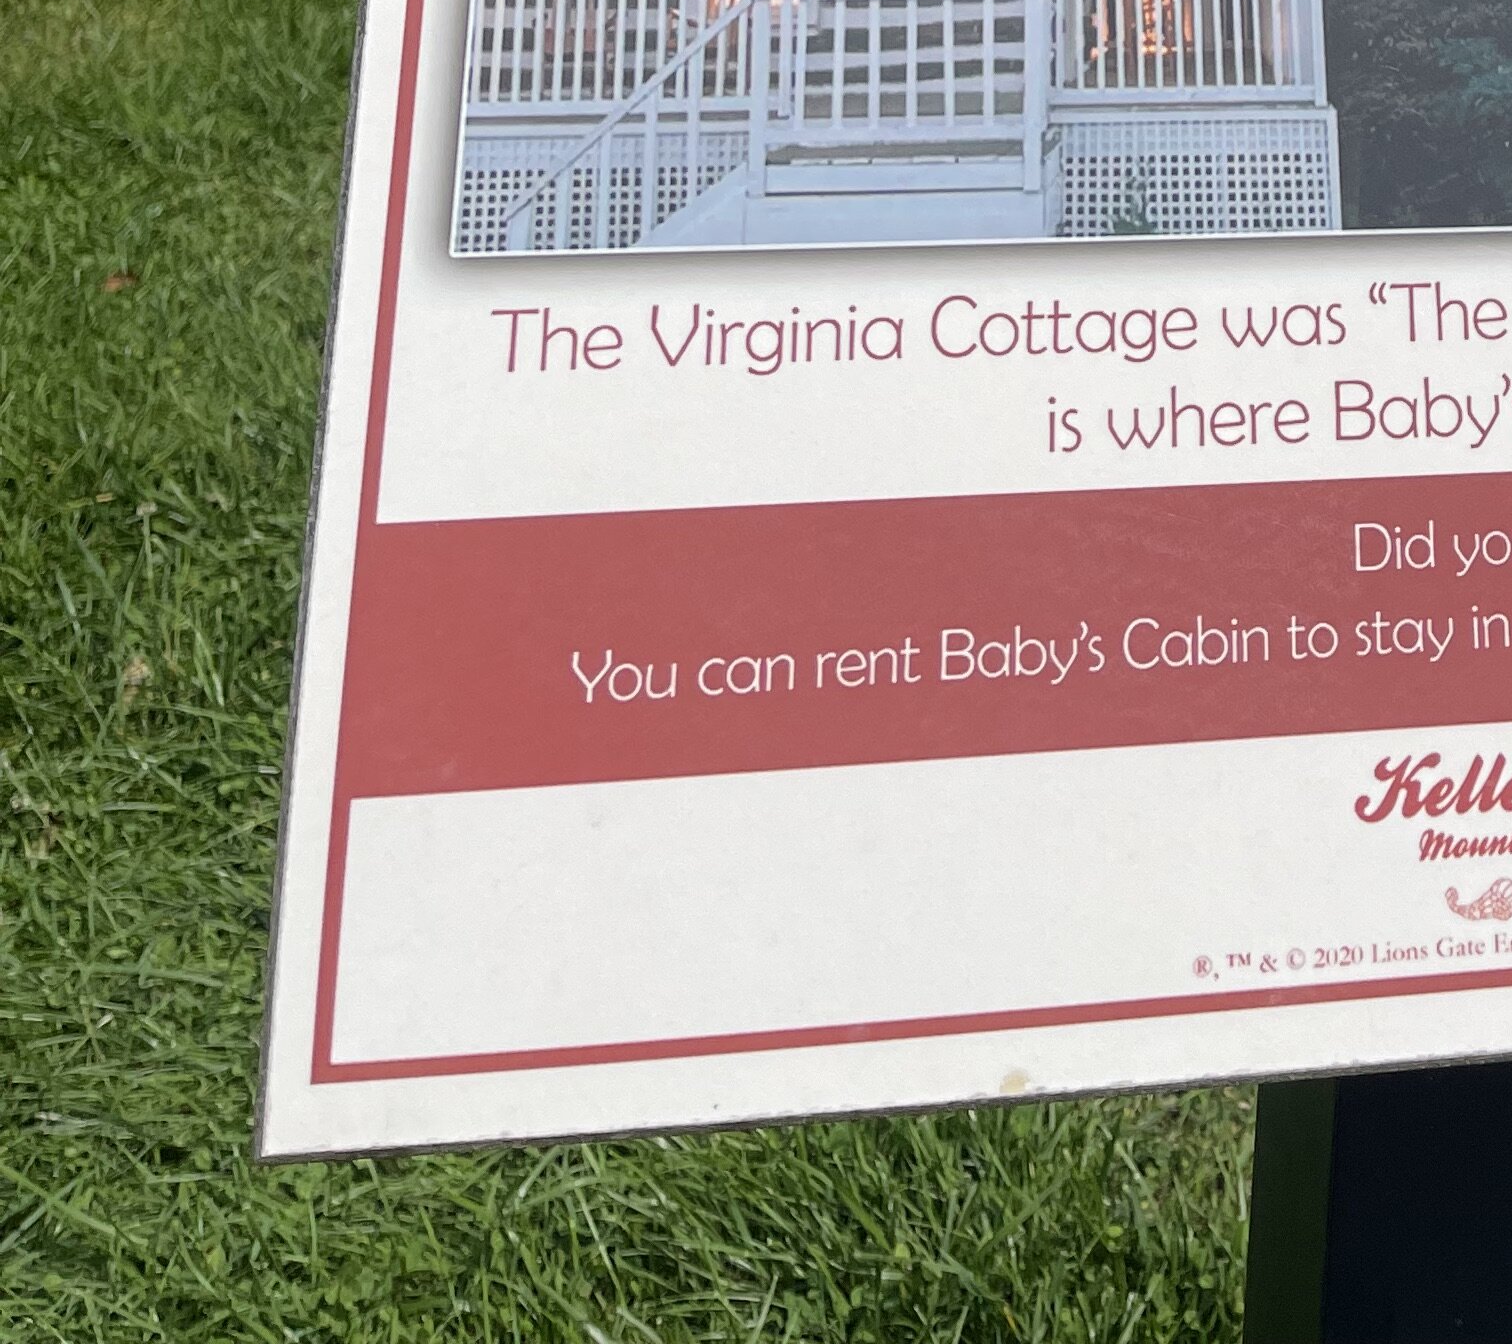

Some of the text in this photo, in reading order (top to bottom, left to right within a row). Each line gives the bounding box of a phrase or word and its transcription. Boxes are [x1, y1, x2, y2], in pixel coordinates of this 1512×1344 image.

[493, 308, 623, 372] The
[651, 304, 903, 376] Virginia
[931, 295, 1198, 363] Cottage
[1221, 303, 1346, 347] was
[1369, 282, 1508, 342] “The
[1049, 397, 1083, 453] is
[1107, 387, 1311, 449] where
[1354, 521, 1435, 571] Did
[572, 650, 677, 702] You
[698, 655, 794, 695] can
[816, 638, 920, 687] rent
[941, 623, 1105, 684] Baby’s
[1123, 616, 1269, 669] Cabin
[1289, 617, 1338, 659] to
[1355, 612, 1453, 661] stay
[1472, 606, 1510, 648] in
[1259, 954, 1277, 973] &
[1286, 947, 1305, 970] ©
[1313, 945, 1363, 969] 2020
[1372, 943, 1428, 963] Lions
[1436, 937, 1485, 958] Gate
